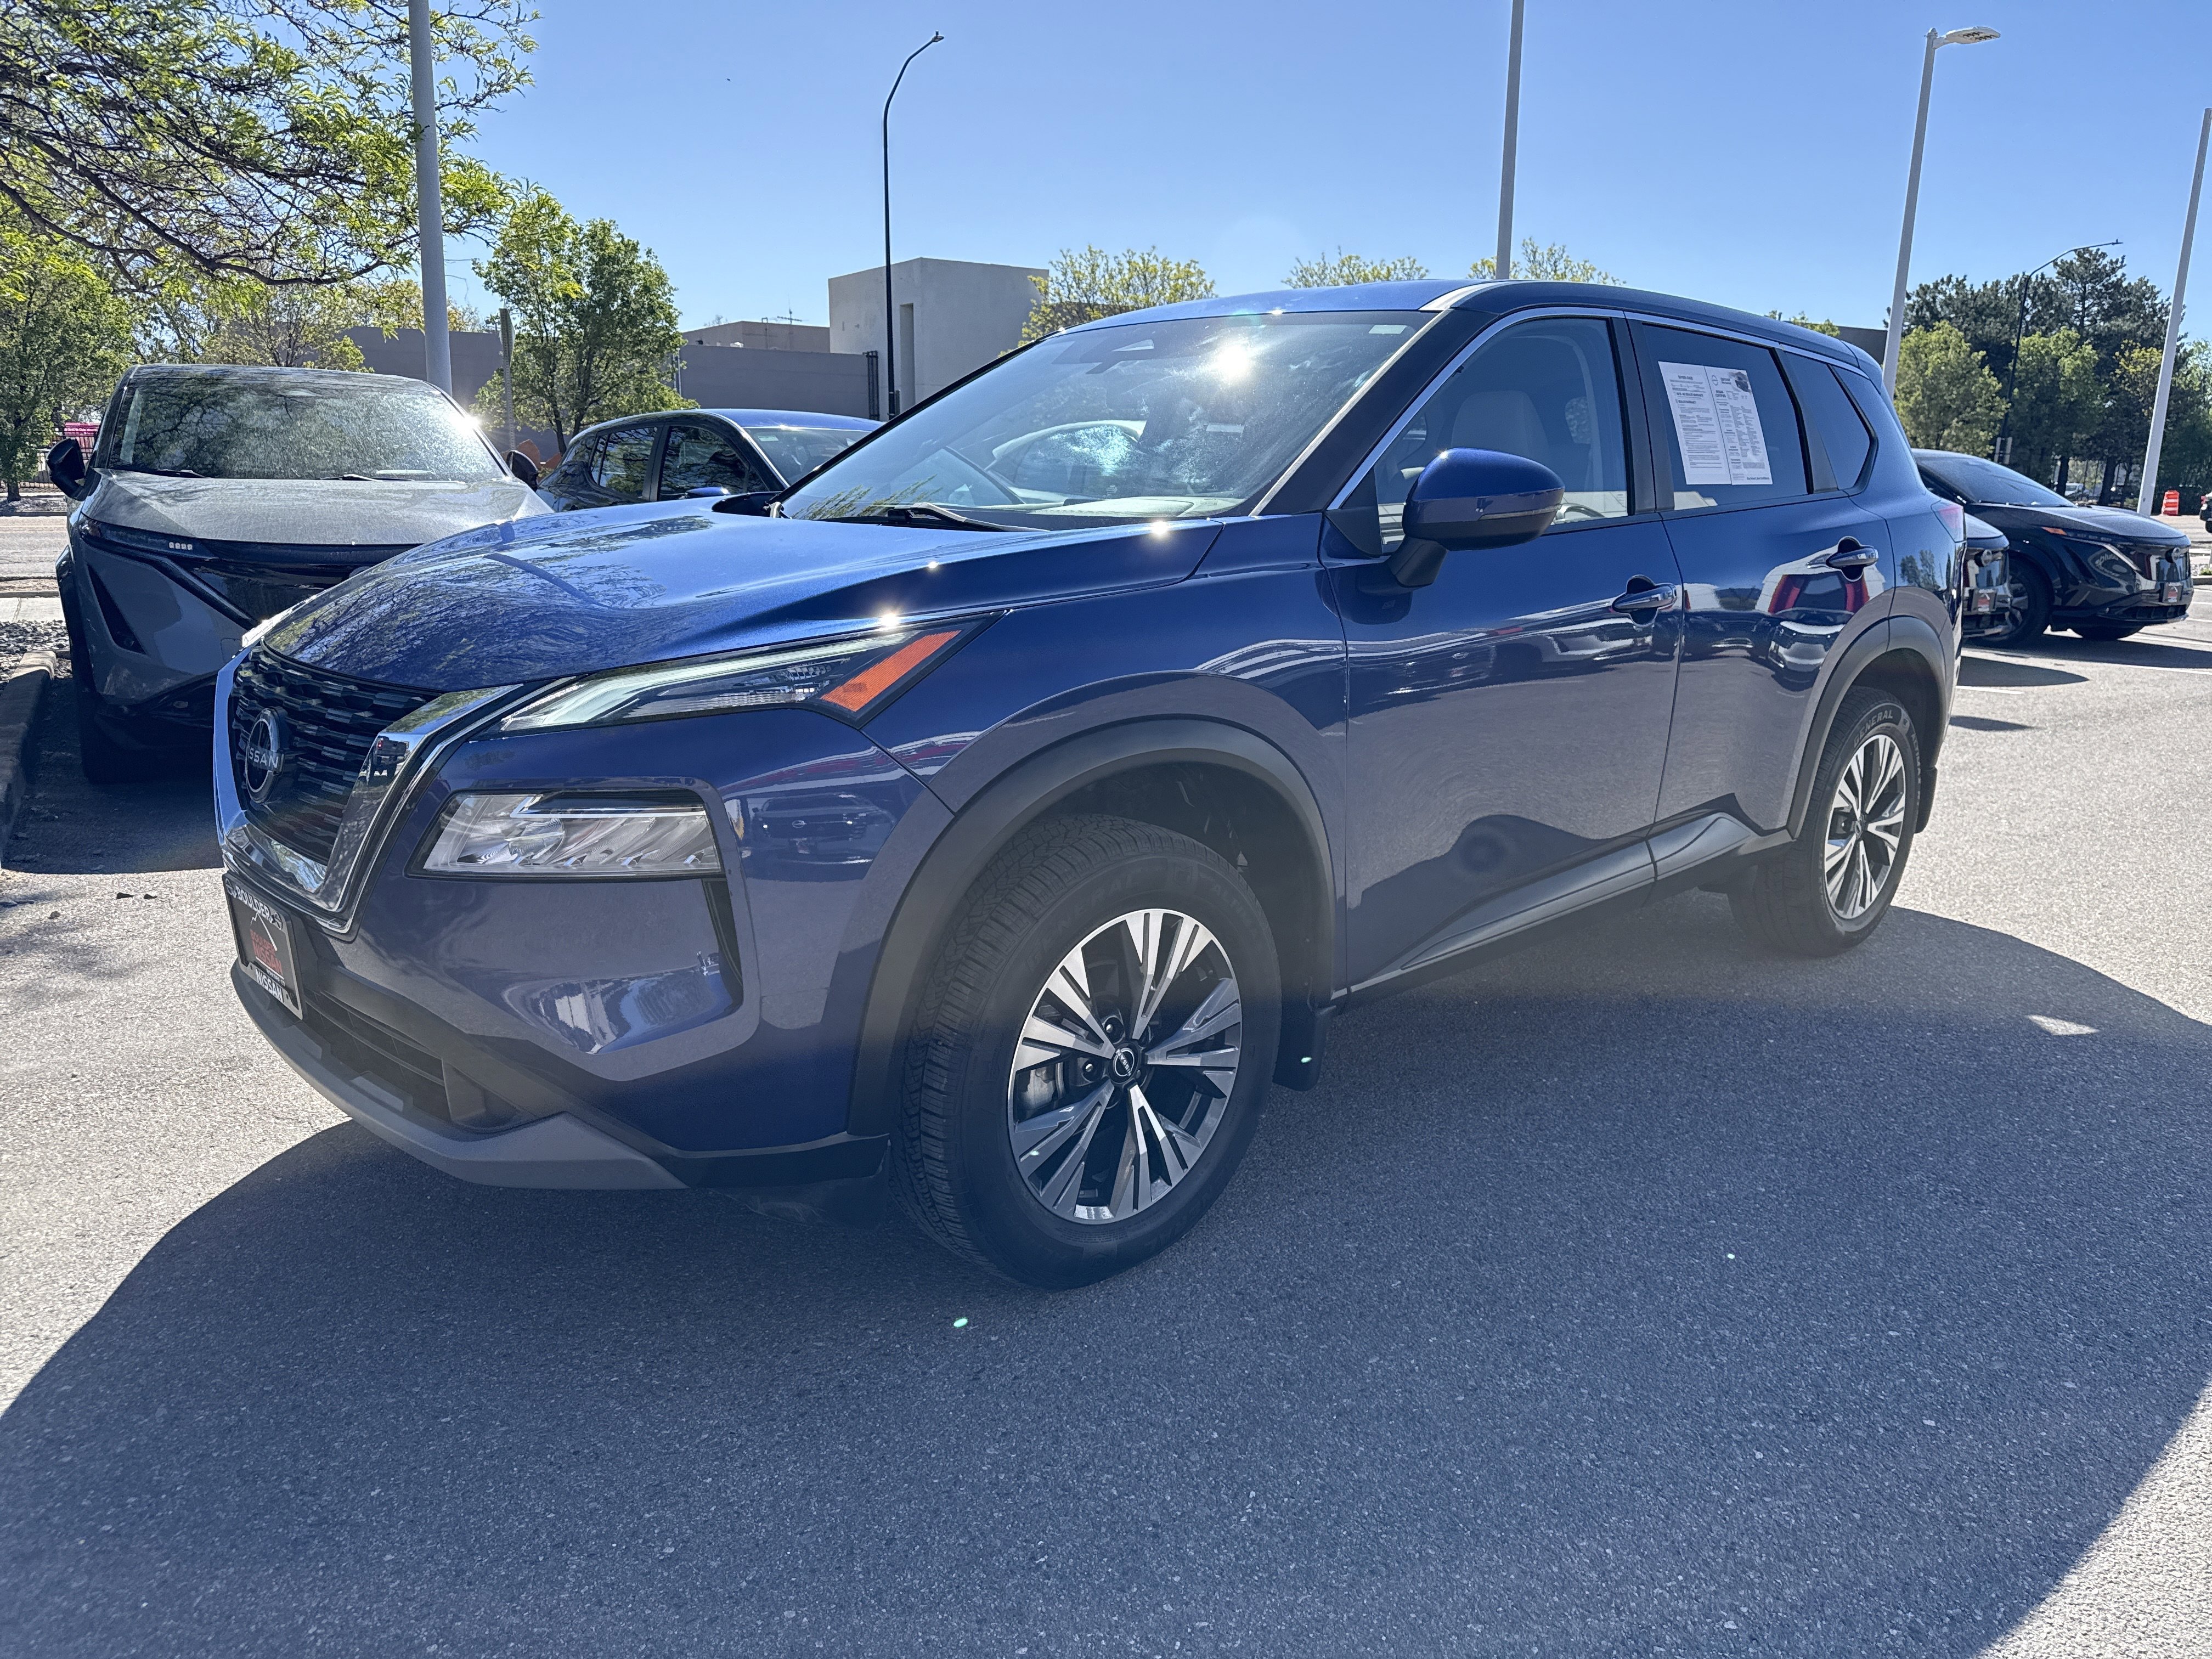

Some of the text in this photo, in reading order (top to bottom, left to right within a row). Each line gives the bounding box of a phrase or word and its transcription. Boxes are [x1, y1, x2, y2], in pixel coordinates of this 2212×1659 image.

[1854, 710, 1893, 748] GENERAL
[249, 747, 279, 769] SSAN
[235, 885, 270, 921] BOULDER
[252, 940, 284, 976] NISSAN
[255, 968, 284, 1003] NISSAN
[1115, 1048, 1132, 1076] NISSAN
